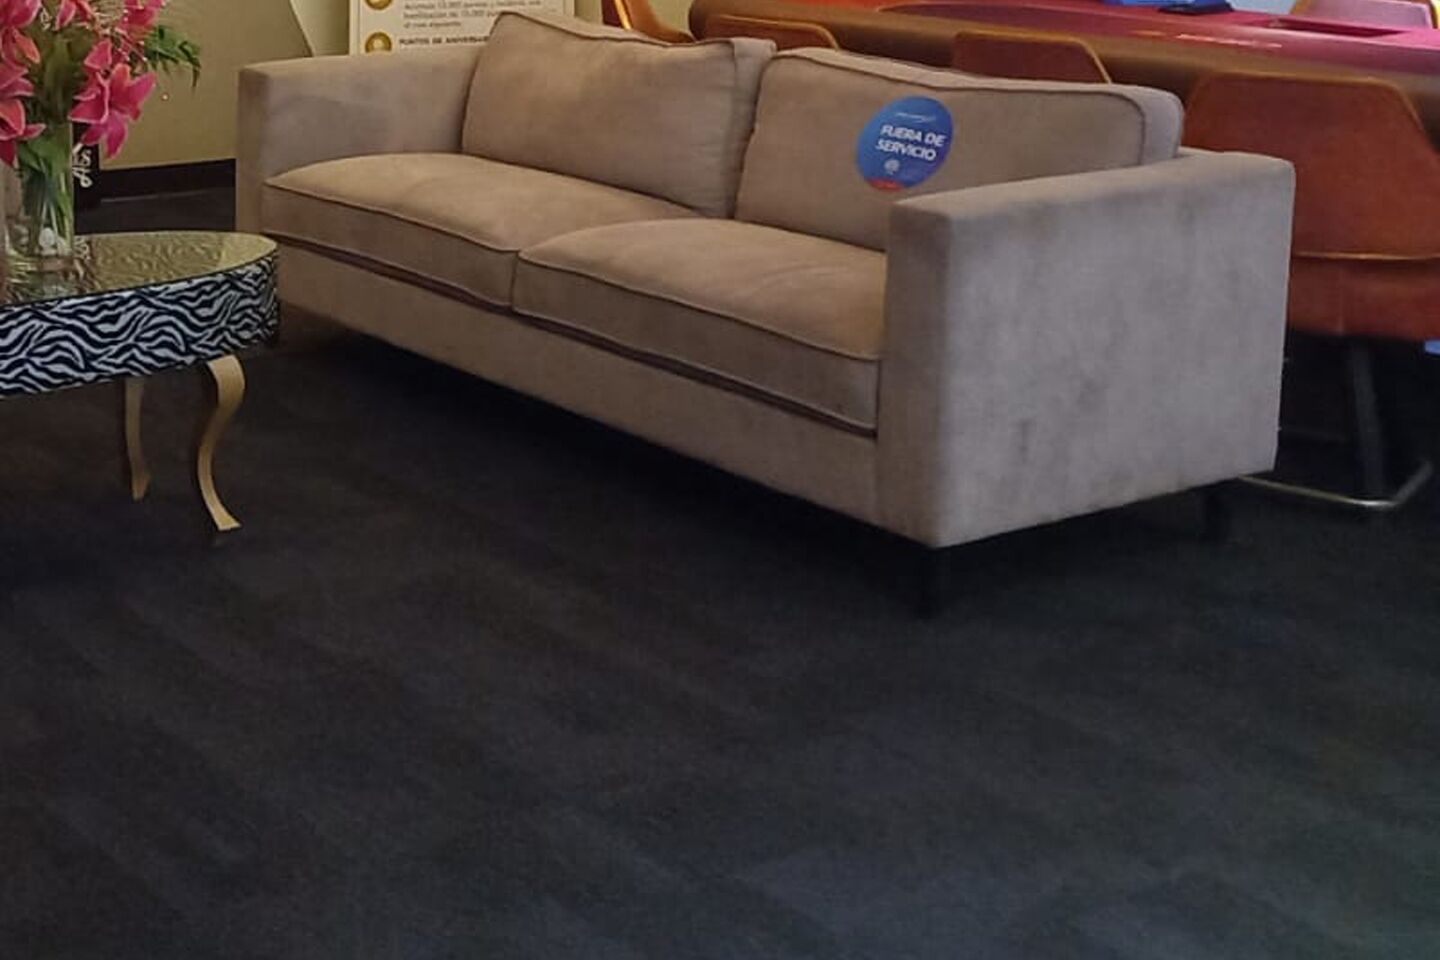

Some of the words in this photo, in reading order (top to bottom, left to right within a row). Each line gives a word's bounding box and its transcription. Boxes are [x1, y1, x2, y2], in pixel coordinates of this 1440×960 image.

[881, 124, 922, 142] FUERA
[924, 132, 946, 147] DE
[875, 138, 937, 161] SERVICIO
